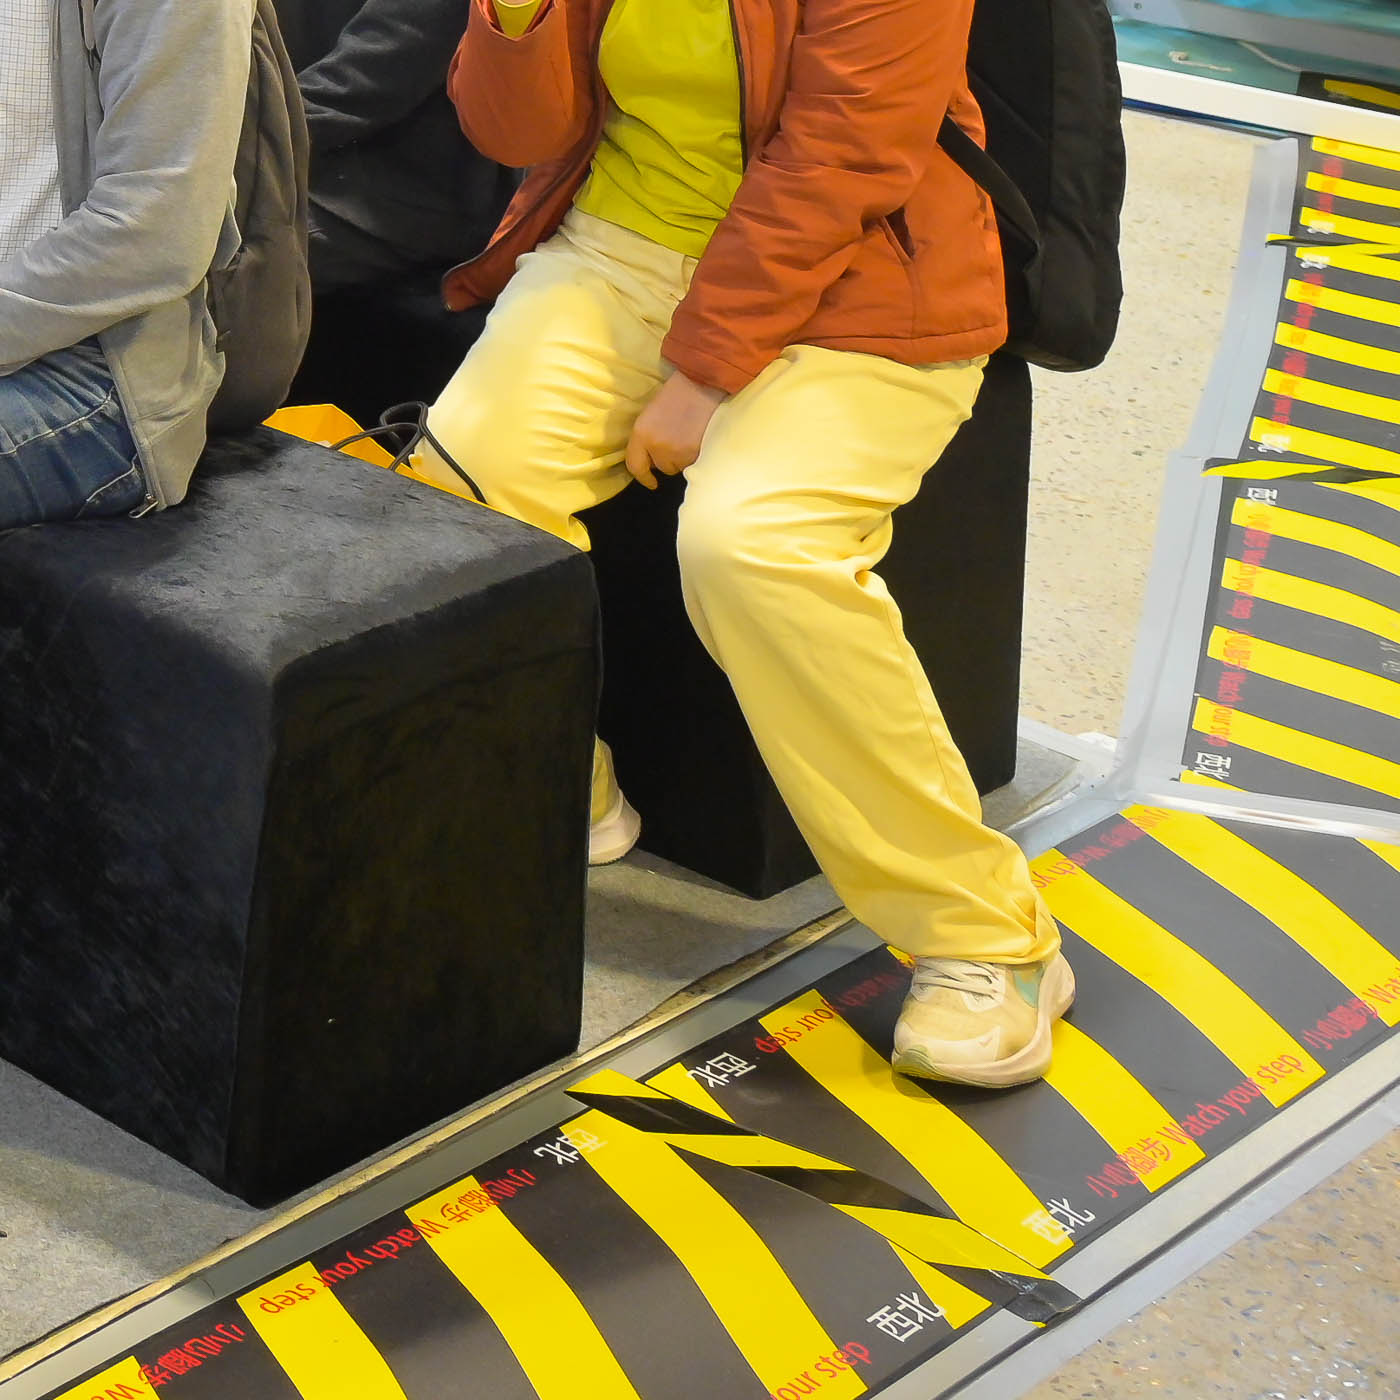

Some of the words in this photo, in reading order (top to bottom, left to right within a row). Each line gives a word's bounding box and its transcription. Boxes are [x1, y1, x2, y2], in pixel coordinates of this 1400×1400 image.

[755, 1025, 803, 1053] step
[1085, 1138, 1172, 1199] 小心腳步
[1159, 1096, 1230, 1146] Watch
[1223, 1076, 1265, 1116] your
[1258, 1053, 1305, 1086] step
[441, 1168, 536, 1222] 小心腳步
[365, 1217, 449, 1260] Watch
[312, 1250, 375, 1289] your
[259, 1282, 316, 1314] step
[138, 1324, 247, 1387] 小心腳步
[814, 1340, 873, 1379] step
